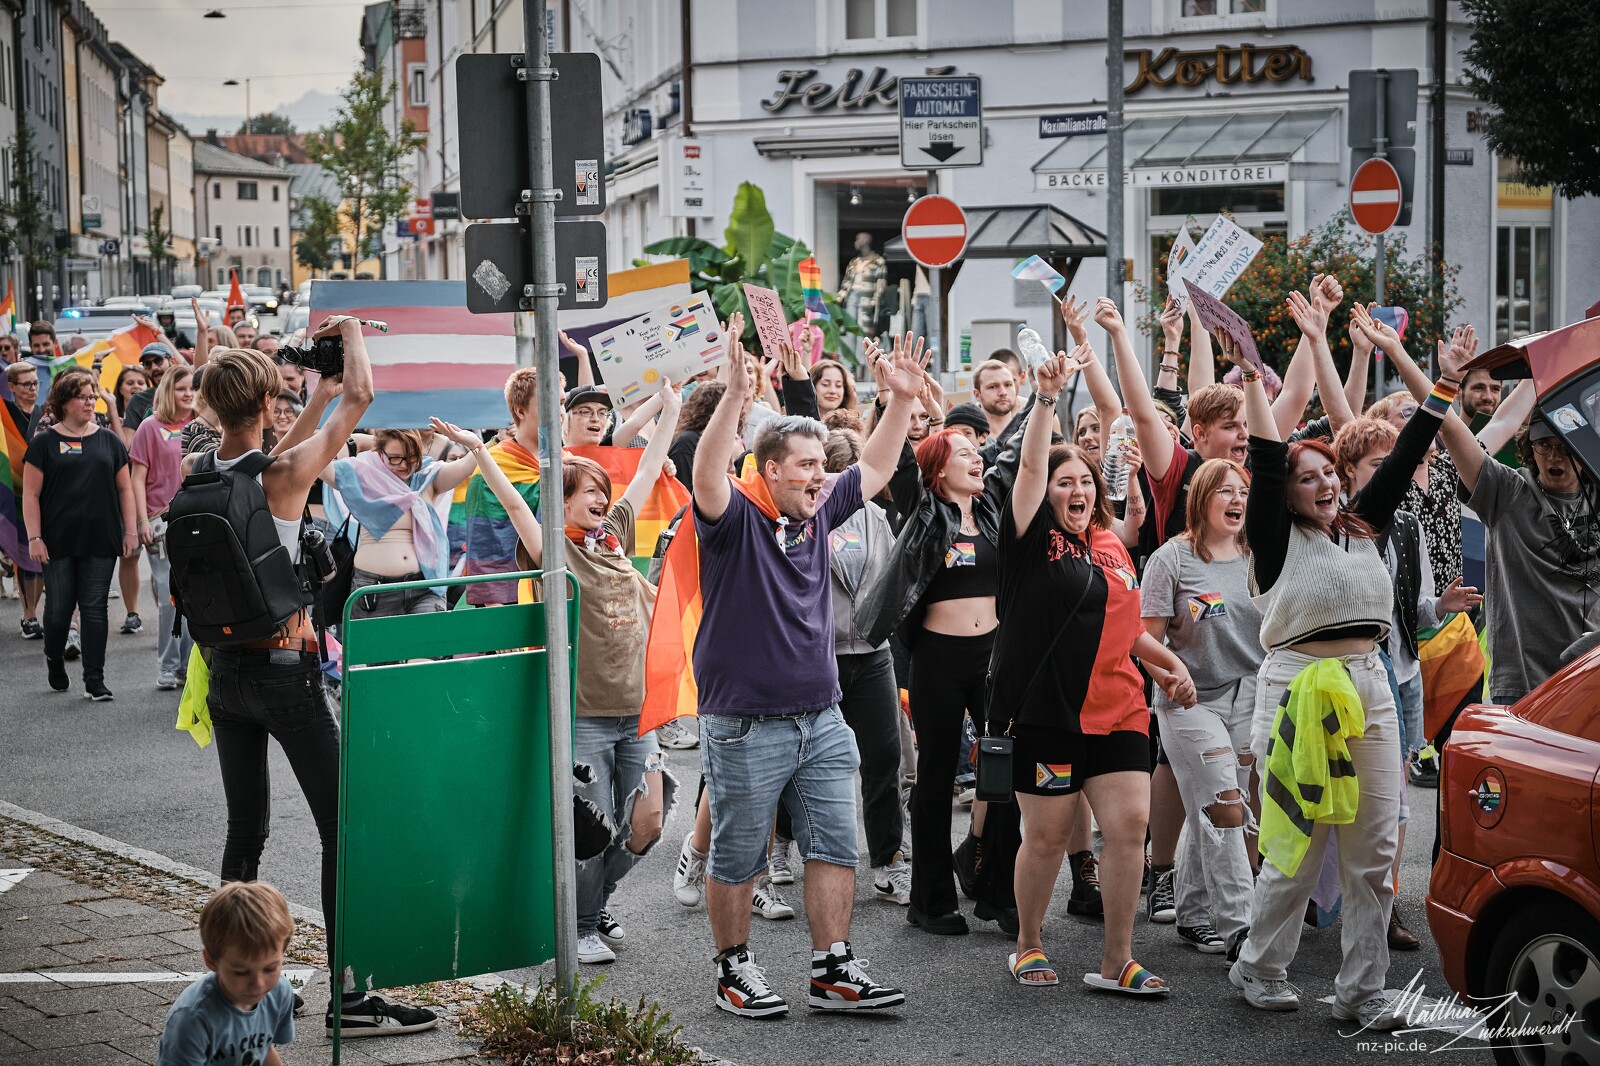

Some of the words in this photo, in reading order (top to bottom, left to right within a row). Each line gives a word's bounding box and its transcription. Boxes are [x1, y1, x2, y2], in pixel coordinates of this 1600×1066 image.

[1122, 43, 1314, 95] Kotter
[904, 82, 976, 98] PARKSCHEIN-
[915, 100, 966, 114] AUTOMAT
[904, 120, 924, 130] Hier
[927, 120, 977, 129] Parkschein
[1041, 115, 1107, 134] Maximilianstraße
[1049, 172, 1136, 186] BÄCKEEI
[1162, 167, 1272, 183] KONDITOREI
[752, 306, 761, 320] not
[764, 294, 784, 344] ATEGORY
